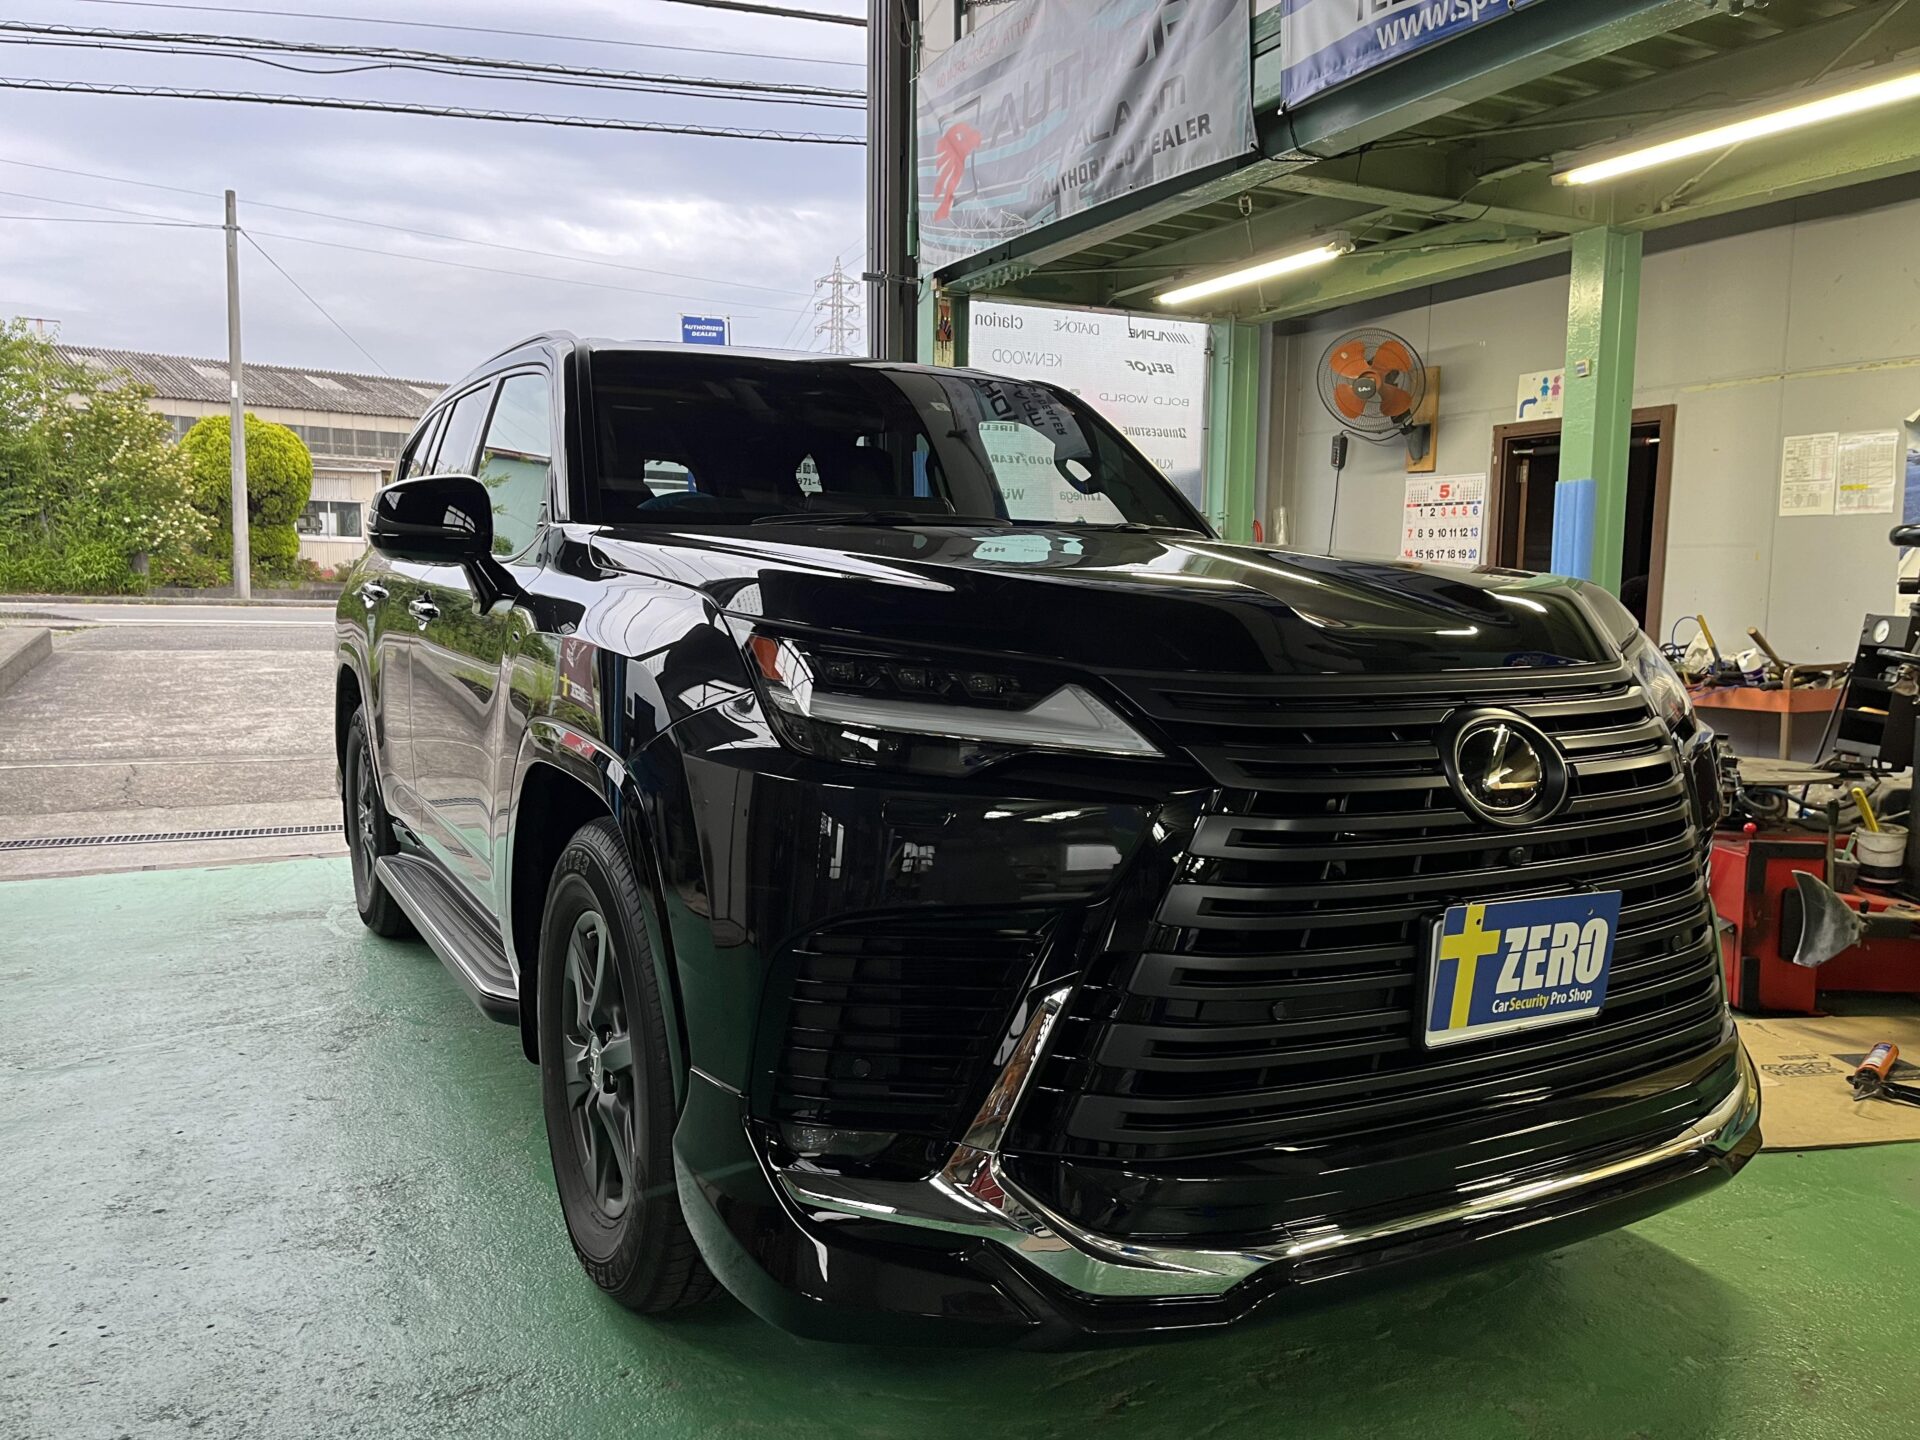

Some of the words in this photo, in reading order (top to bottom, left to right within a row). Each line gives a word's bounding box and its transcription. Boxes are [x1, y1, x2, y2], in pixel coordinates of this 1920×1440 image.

[684, 323, 724, 332] AUTHORIZED
[1439, 484, 1450, 499] 5
[1419, 508, 1424, 517] 1
[1430, 508, 1436, 517] 2
[1440, 507, 1447, 517] 3
[1451, 507, 1457, 516] 4
[1461, 506, 1468, 516] 5
[1472, 506, 1479, 516] 6
[1407, 529, 1413, 538] 7
[1417, 529, 1424, 538] 8
[1428, 529, 1434, 538] 9
[1437, 528, 1447, 538] 10
[1449, 528, 1457, 537] 11
[1459, 528, 1468, 537] 12
[1470, 528, 1478, 537] 13
[1404, 548, 1413, 558] 14
[1415, 549, 1424, 559] 15
[1425, 549, 1434, 559] 16
[1436, 549, 1445, 559] 17
[1447, 549, 1456, 559] 18
[1458, 549, 1467, 559] 19
[1468, 549, 1477, 559] 20
[1495, 917, 1609, 995] ZERO
[1492, 1000, 1509, 1014] Car
[1509, 994, 1549, 1011] Security
[1550, 991, 1567, 1005] Pro
[1568, 988, 1593, 1004] Shop
